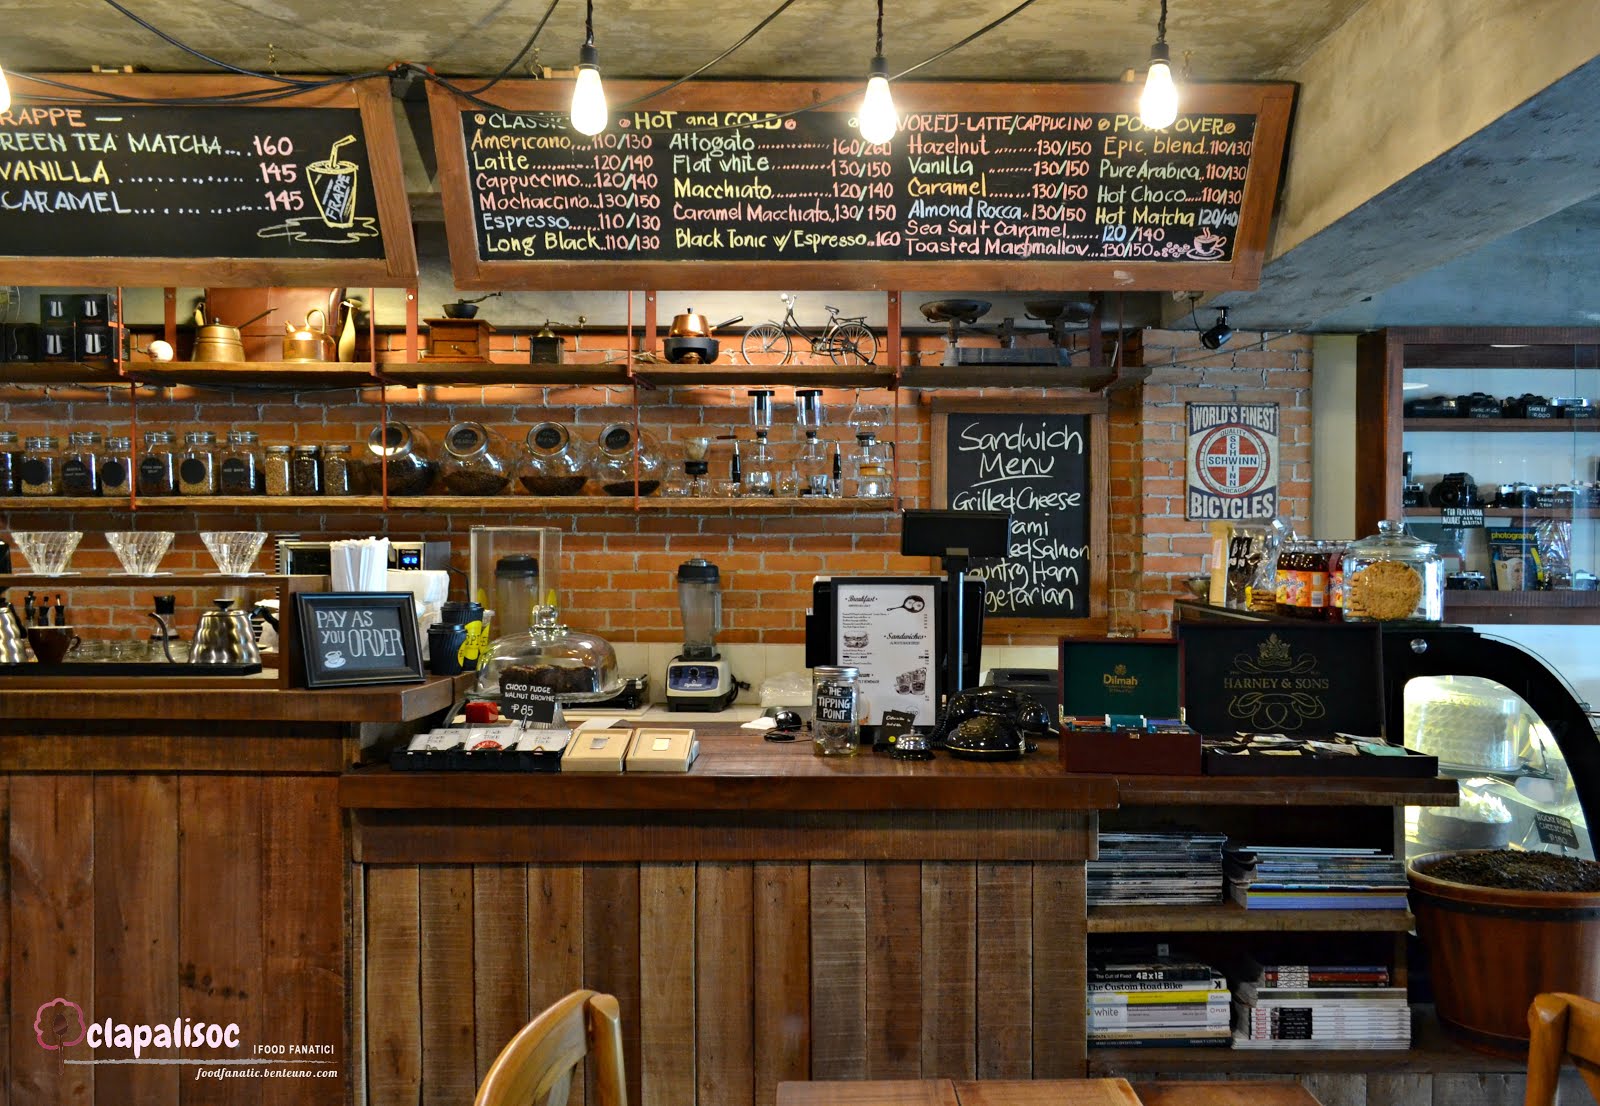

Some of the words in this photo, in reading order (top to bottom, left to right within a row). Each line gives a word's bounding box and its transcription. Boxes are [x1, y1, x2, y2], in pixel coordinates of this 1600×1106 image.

[0, 108, 86, 127] RAPPE
[635, 111, 677, 130] HOT
[686, 112, 718, 127] and
[725, 112, 782, 129] COLD
[1175, 118, 1224, 135] OVER
[0, 132, 67, 152] REEN
[72, 133, 117, 152] TEA
[128, 133, 222, 155] MATCHA
[253, 136, 293, 157] 160
[471, 129, 571, 150] Americano
[592, 133, 653, 150] 110/130
[907, 134, 990, 155] Hazelnut
[1036, 140, 1092, 156] 130/150
[1104, 136, 1145, 159] Epic
[1153, 136, 1205, 155] blend
[1209, 141, 1252, 156] 110/130
[474, 151, 529, 171] Latte
[594, 155, 653, 172] 120/140
[673, 153, 711, 174] Flat
[719, 153, 770, 173] white
[830, 161, 892, 178] 130/150
[908, 156, 974, 175] Vanilla
[1034, 160, 1090, 177] 130/150
[1205, 163, 1246, 180] 110/130
[260, 162, 297, 183] 145
[476, 173, 580, 195] Cappuccino
[595, 173, 658, 191] 120/140
[674, 176, 772, 199] Macchiato
[833, 182, 893, 201] 120/140
[908, 173, 987, 197] Caramel
[1032, 181, 1088, 200] 130/150
[1, 190, 131, 214] CARAMEL
[265, 190, 304, 212] 145
[325, 174, 351, 220] FRAPPE
[479, 192, 589, 211] Mochaccino
[598, 193, 661, 209] 130/150
[1097, 185, 1126, 203] Hot
[1131, 185, 1187, 204] Choco
[1202, 187, 1242, 205] 110/130
[673, 201, 742, 222] Caramel
[747, 199, 829, 222] Macchiato
[834, 203, 896, 222] 130/150
[908, 197, 973, 219] Almond
[977, 200, 1022, 220] Rocca
[1031, 204, 1087, 221] 130/150
[1095, 206, 1126, 225] Hot
[1133, 205, 1196, 227] Matcha
[483, 213, 570, 232] Espresso
[598, 213, 661, 231] 110/130
[905, 219, 942, 235] Sea
[948, 219, 990, 235] Salt
[993, 221, 1067, 238] Caramel
[487, 234, 536, 256] Long
[545, 231, 600, 250] Black
[605, 234, 660, 251] 110/130
[676, 227, 724, 248] Black
[727, 229, 767, 248] Tonic
[794, 230, 867, 253] Espresso
[875, 232, 901, 247] 160
[905, 237, 980, 256] Toasted
[1103, 243, 1154, 258] 130/150
[1191, 405, 1238, 432] WORLD'S
[1240, 405, 1275, 433] FINEST
[958, 422, 1083, 454] Sandwich
[1220, 428, 1247, 437] QUALITY
[979, 452, 1055, 478] Menu
[1208, 456, 1258, 465] SCHWINN
[1190, 492, 1274, 519] BICYCLES
[1032, 538, 1091, 560] Salmon
[1033, 560, 1079, 585] Ham
[984, 581, 1074, 612] getarian
[315, 610, 347, 628] PAY
[351, 610, 373, 628] AS
[321, 630, 346, 644] YOU
[348, 628, 405, 657] ORDER
[505, 683, 528, 692] CHOCO
[530, 685, 551, 694] FUDGE
[1103, 673, 1138, 686] Dilmah
[1224, 677, 1278, 689] HARNEY
[1281, 677, 1292, 689] &
[1295, 677, 1329, 689] SONS
[504, 691, 529, 700] WALNUT
[530, 693, 555, 702] BROWNIE
[828, 686, 842, 697] THE
[817, 696, 850, 709] TIPPING
[823, 708, 847, 720] POINT
[1087, 983, 1103, 992] The
[1104, 983, 1139, 991] Custom
[1140, 982, 1162, 991] Road
[1163, 982, 1183, 990] Bike
[1094, 1007, 1119, 1017] white
